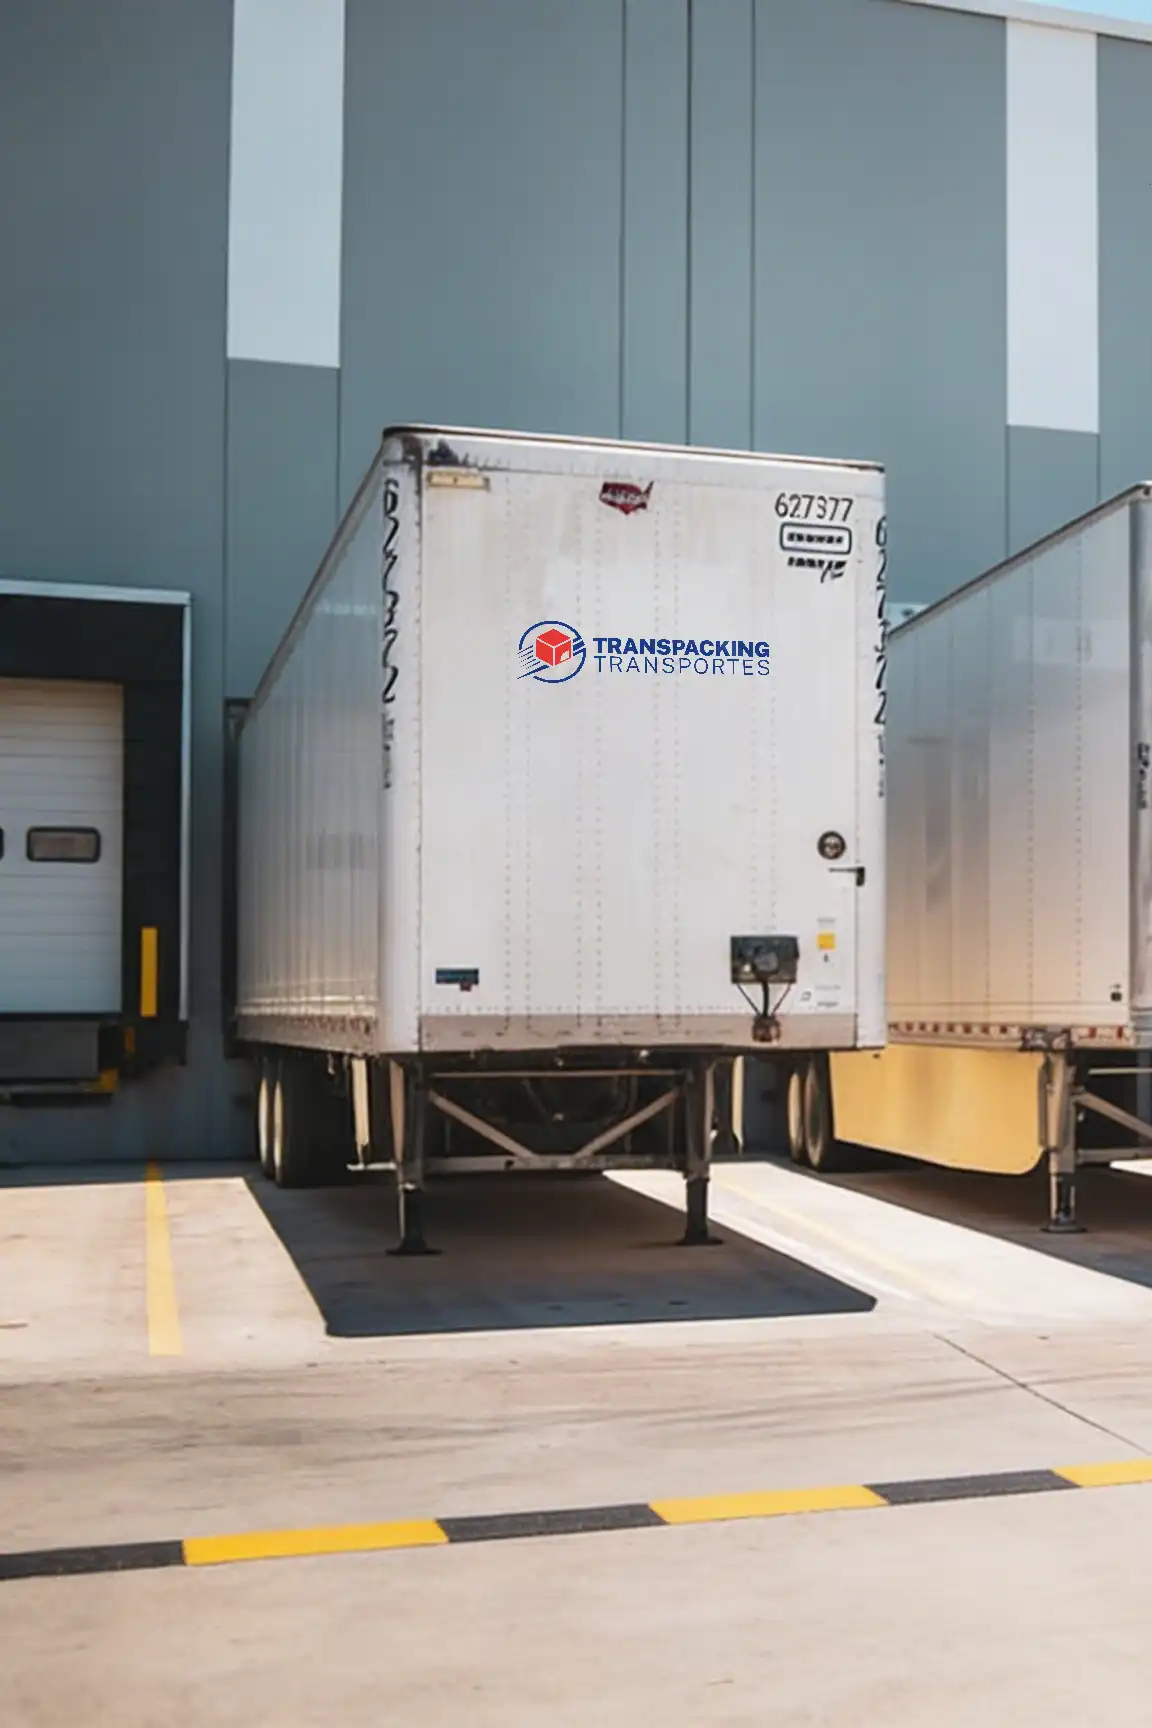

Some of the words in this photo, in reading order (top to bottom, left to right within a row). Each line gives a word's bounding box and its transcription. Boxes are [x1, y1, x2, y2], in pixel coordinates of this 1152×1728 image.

[774, 492, 854, 522] 627377
[593, 637, 770, 658] TRANSPACKING
[594, 655, 770, 675] TRANSPORTES
